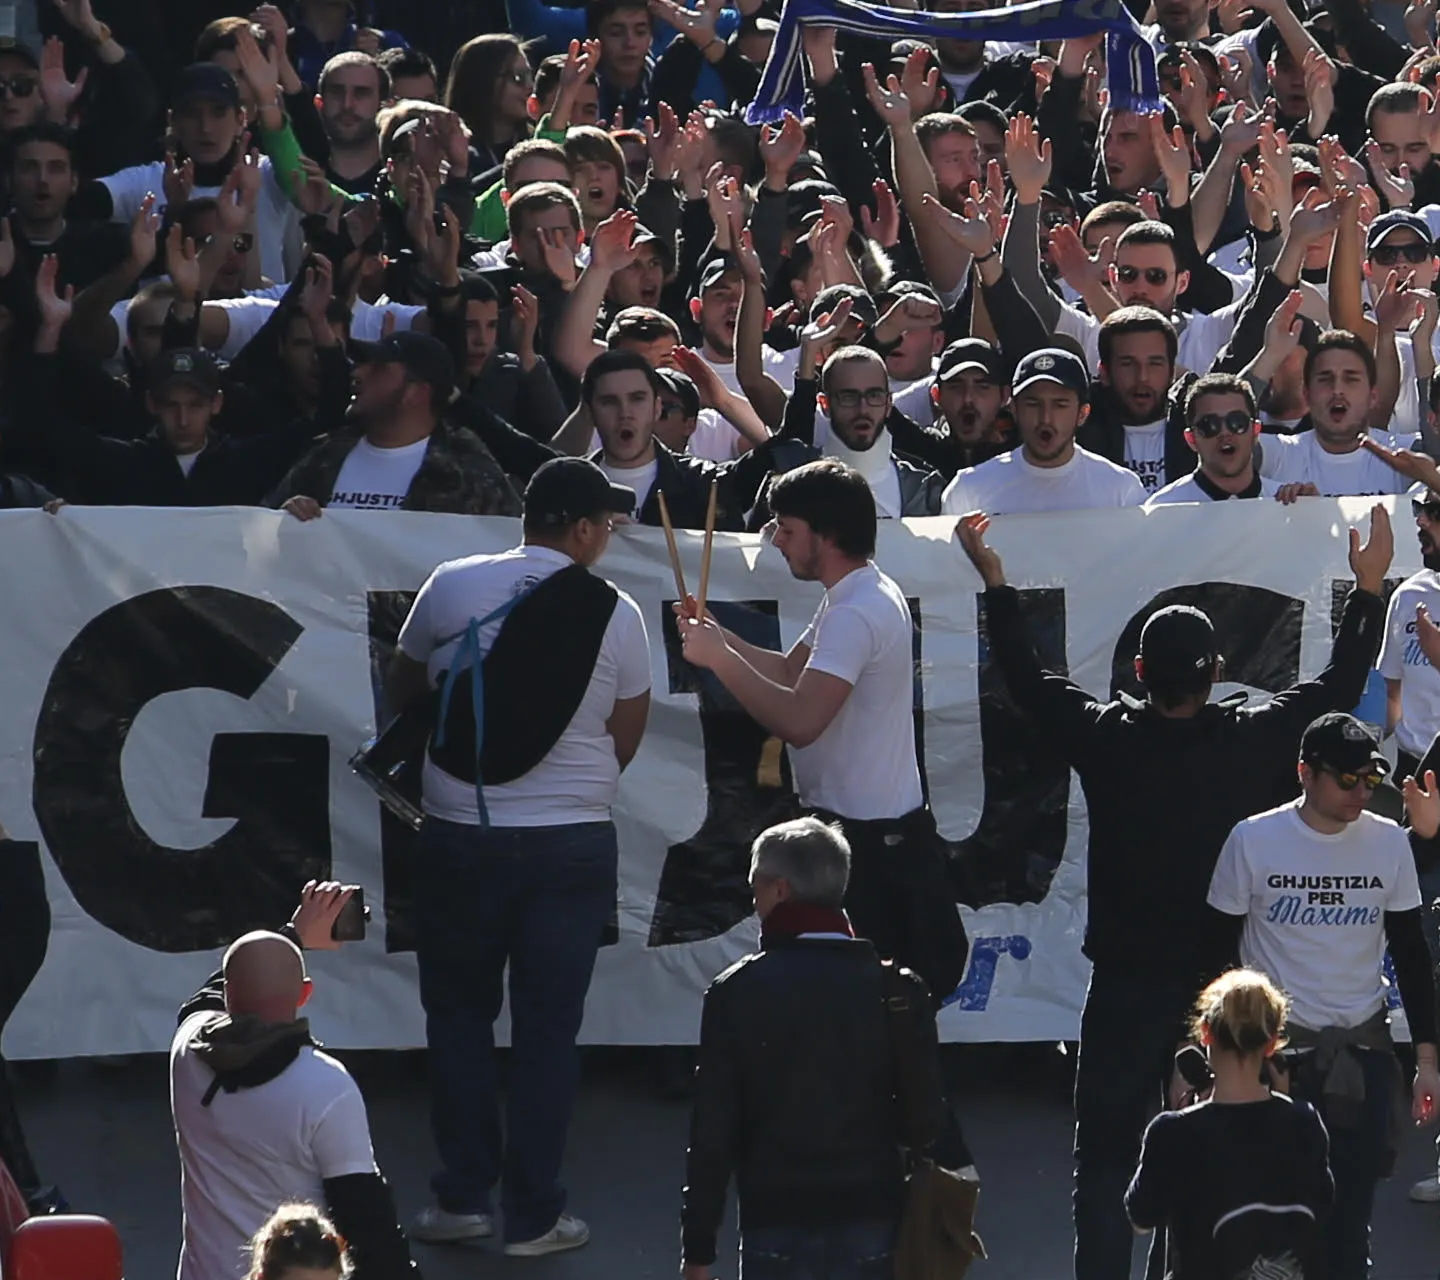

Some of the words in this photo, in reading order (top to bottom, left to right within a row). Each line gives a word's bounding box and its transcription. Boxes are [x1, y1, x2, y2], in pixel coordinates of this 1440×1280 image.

[1267, 874, 1384, 890] GHJUSTIZIA
[1307, 891, 1346, 905] PER
[1266, 892, 1380, 928] Maxime
